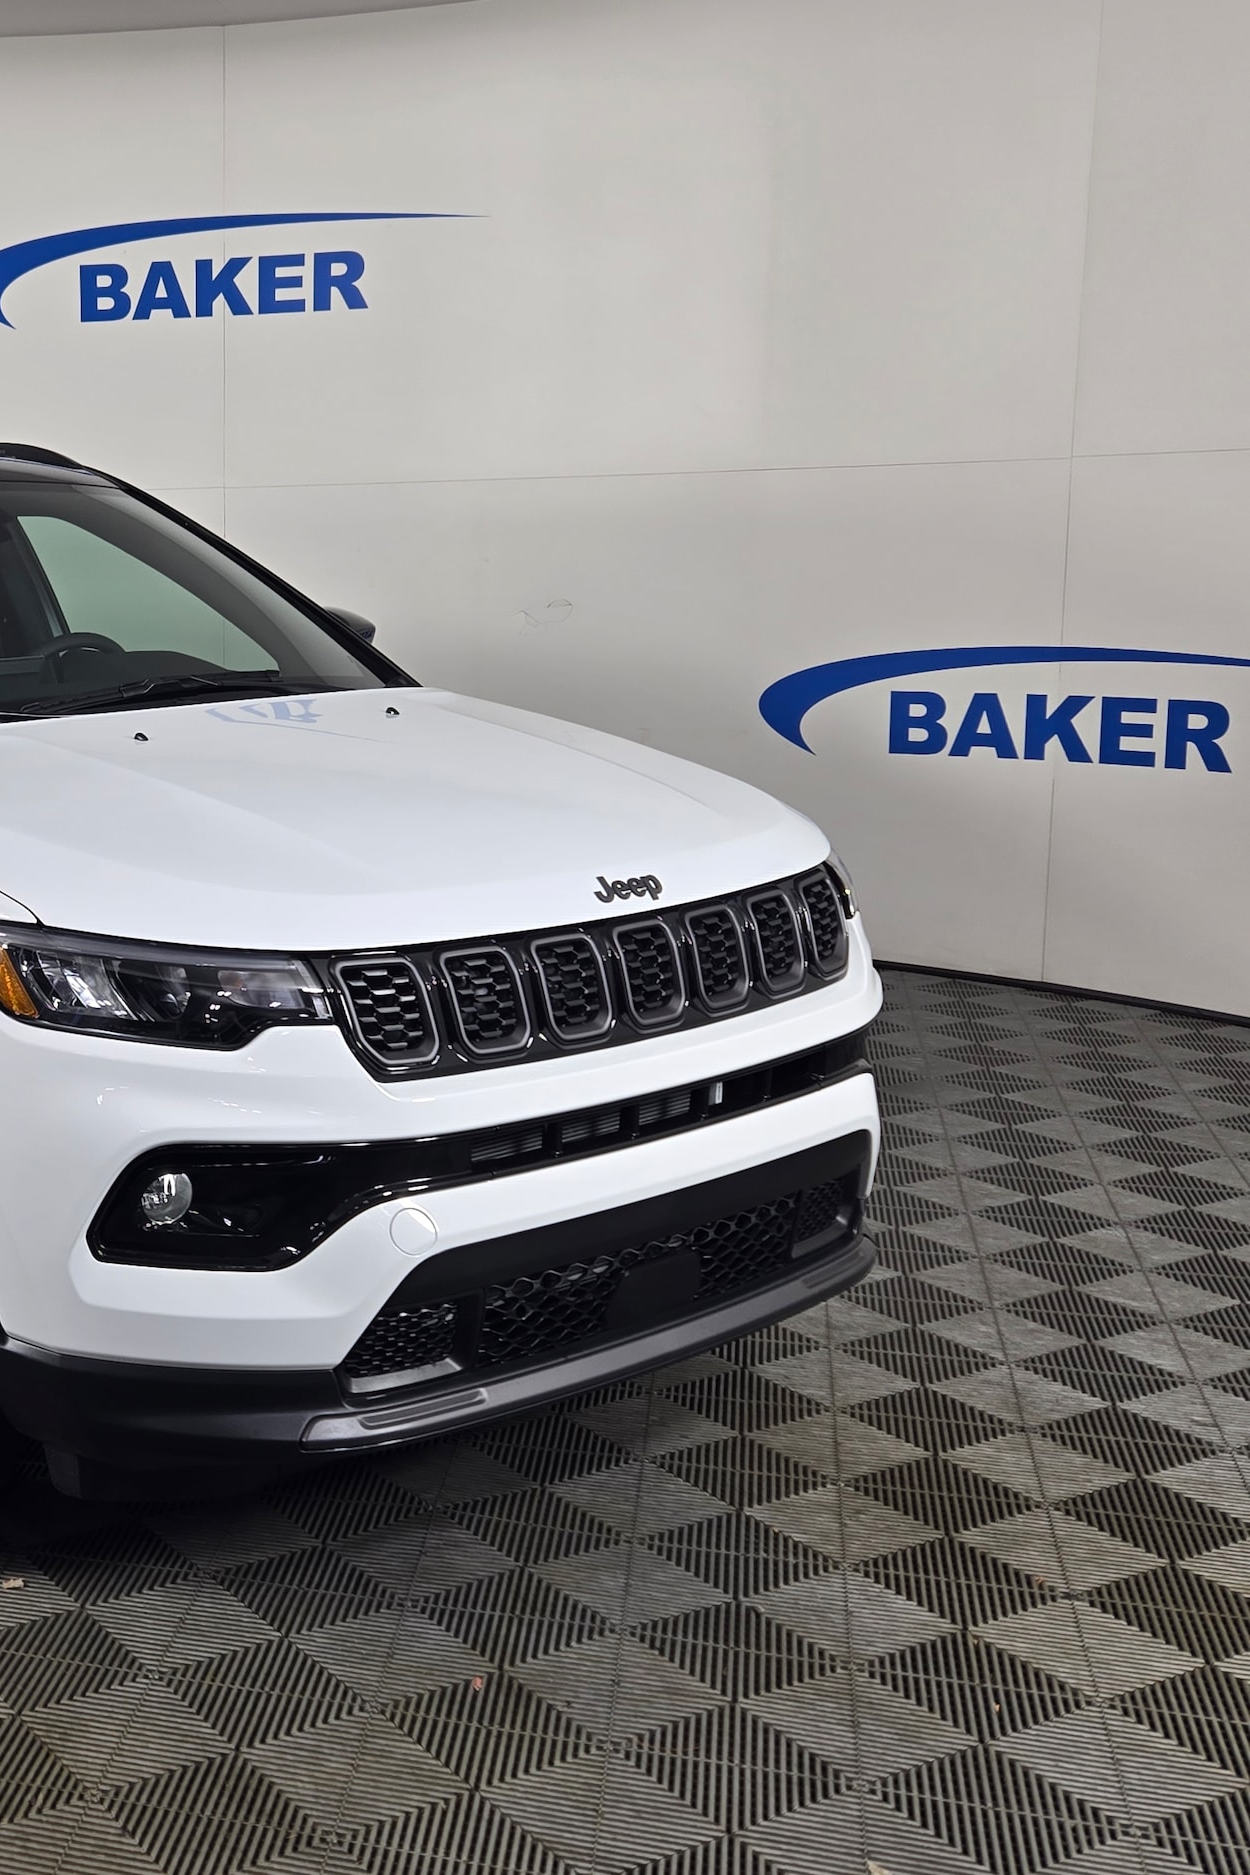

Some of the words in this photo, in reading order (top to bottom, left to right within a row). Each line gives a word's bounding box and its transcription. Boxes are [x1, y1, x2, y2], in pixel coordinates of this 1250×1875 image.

[79, 250, 369, 323] BAKER
[888, 690, 1233, 773] BAKER
[593, 874, 663, 903] Jeep
